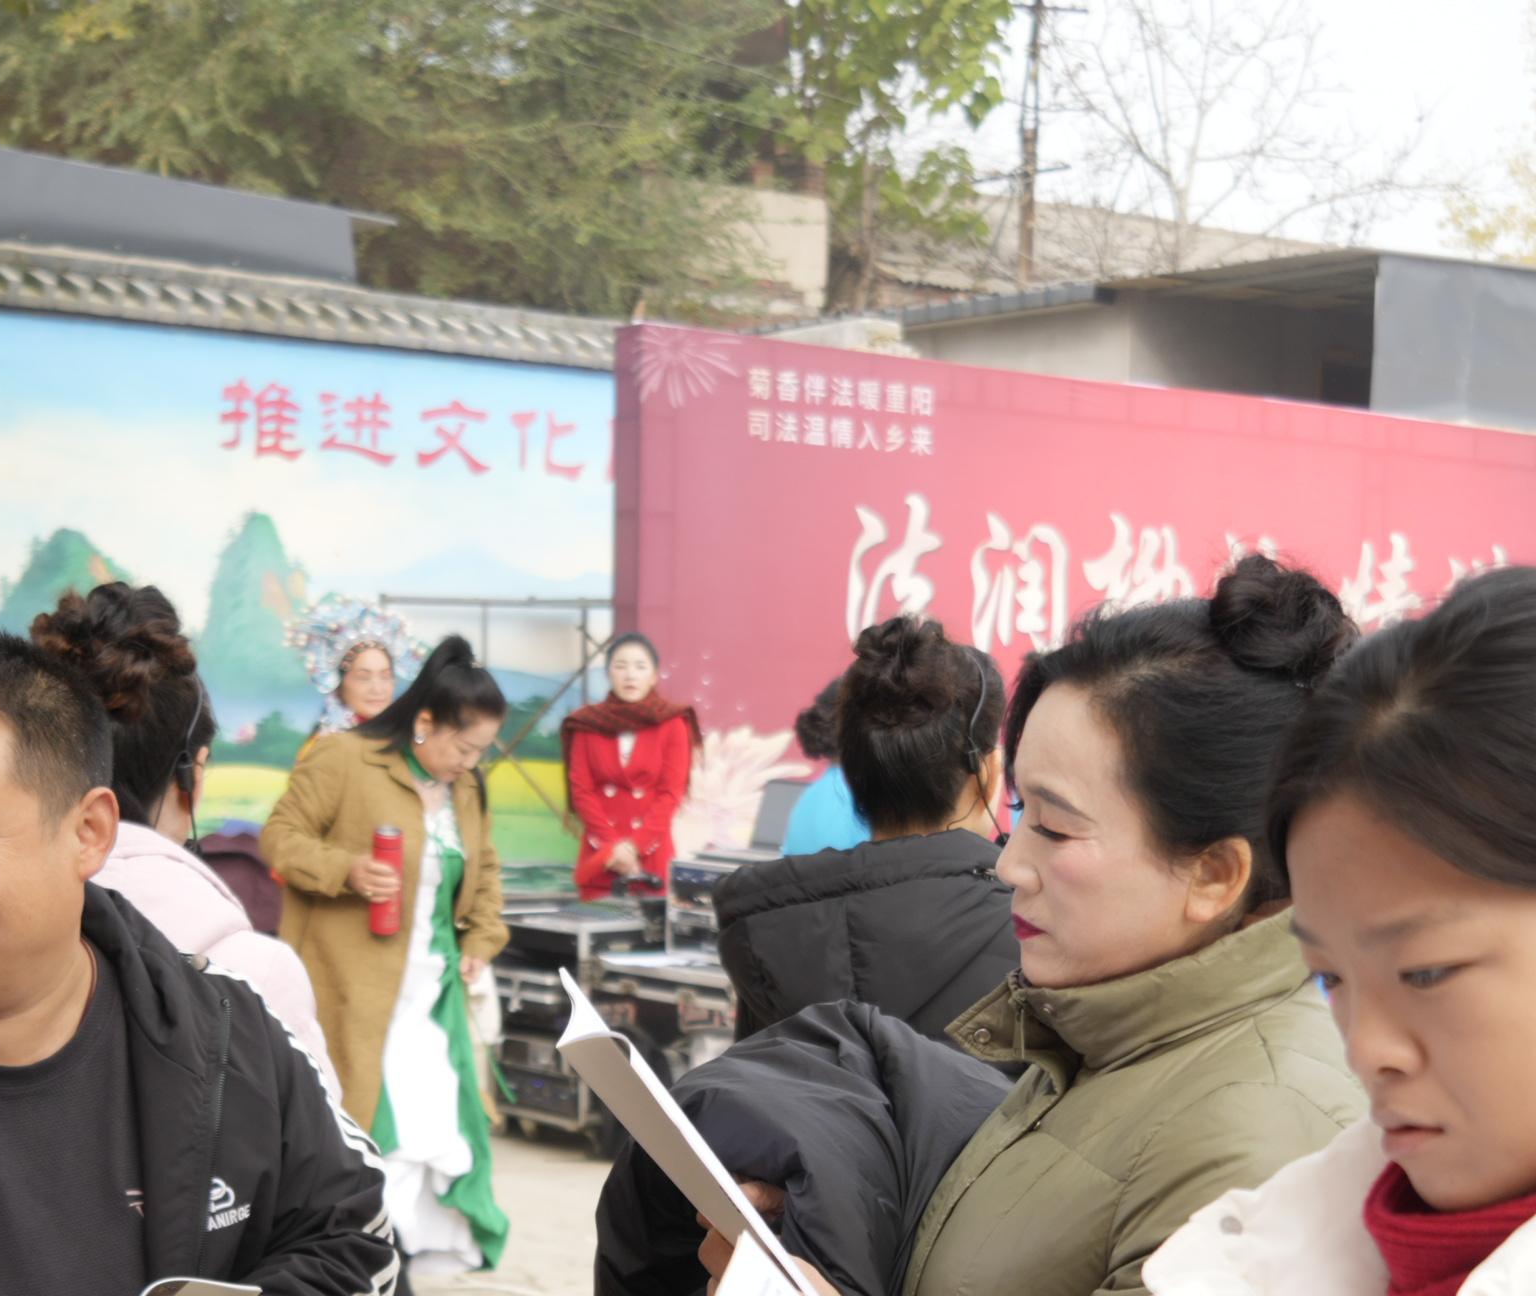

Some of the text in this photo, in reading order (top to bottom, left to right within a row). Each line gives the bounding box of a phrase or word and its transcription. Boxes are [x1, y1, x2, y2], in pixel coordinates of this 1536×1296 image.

[748, 367, 935, 416] 菊香伴法暖重阳
[220, 378, 616, 483] 推进文化
[748, 408, 934, 456] 司法温情入乡来
